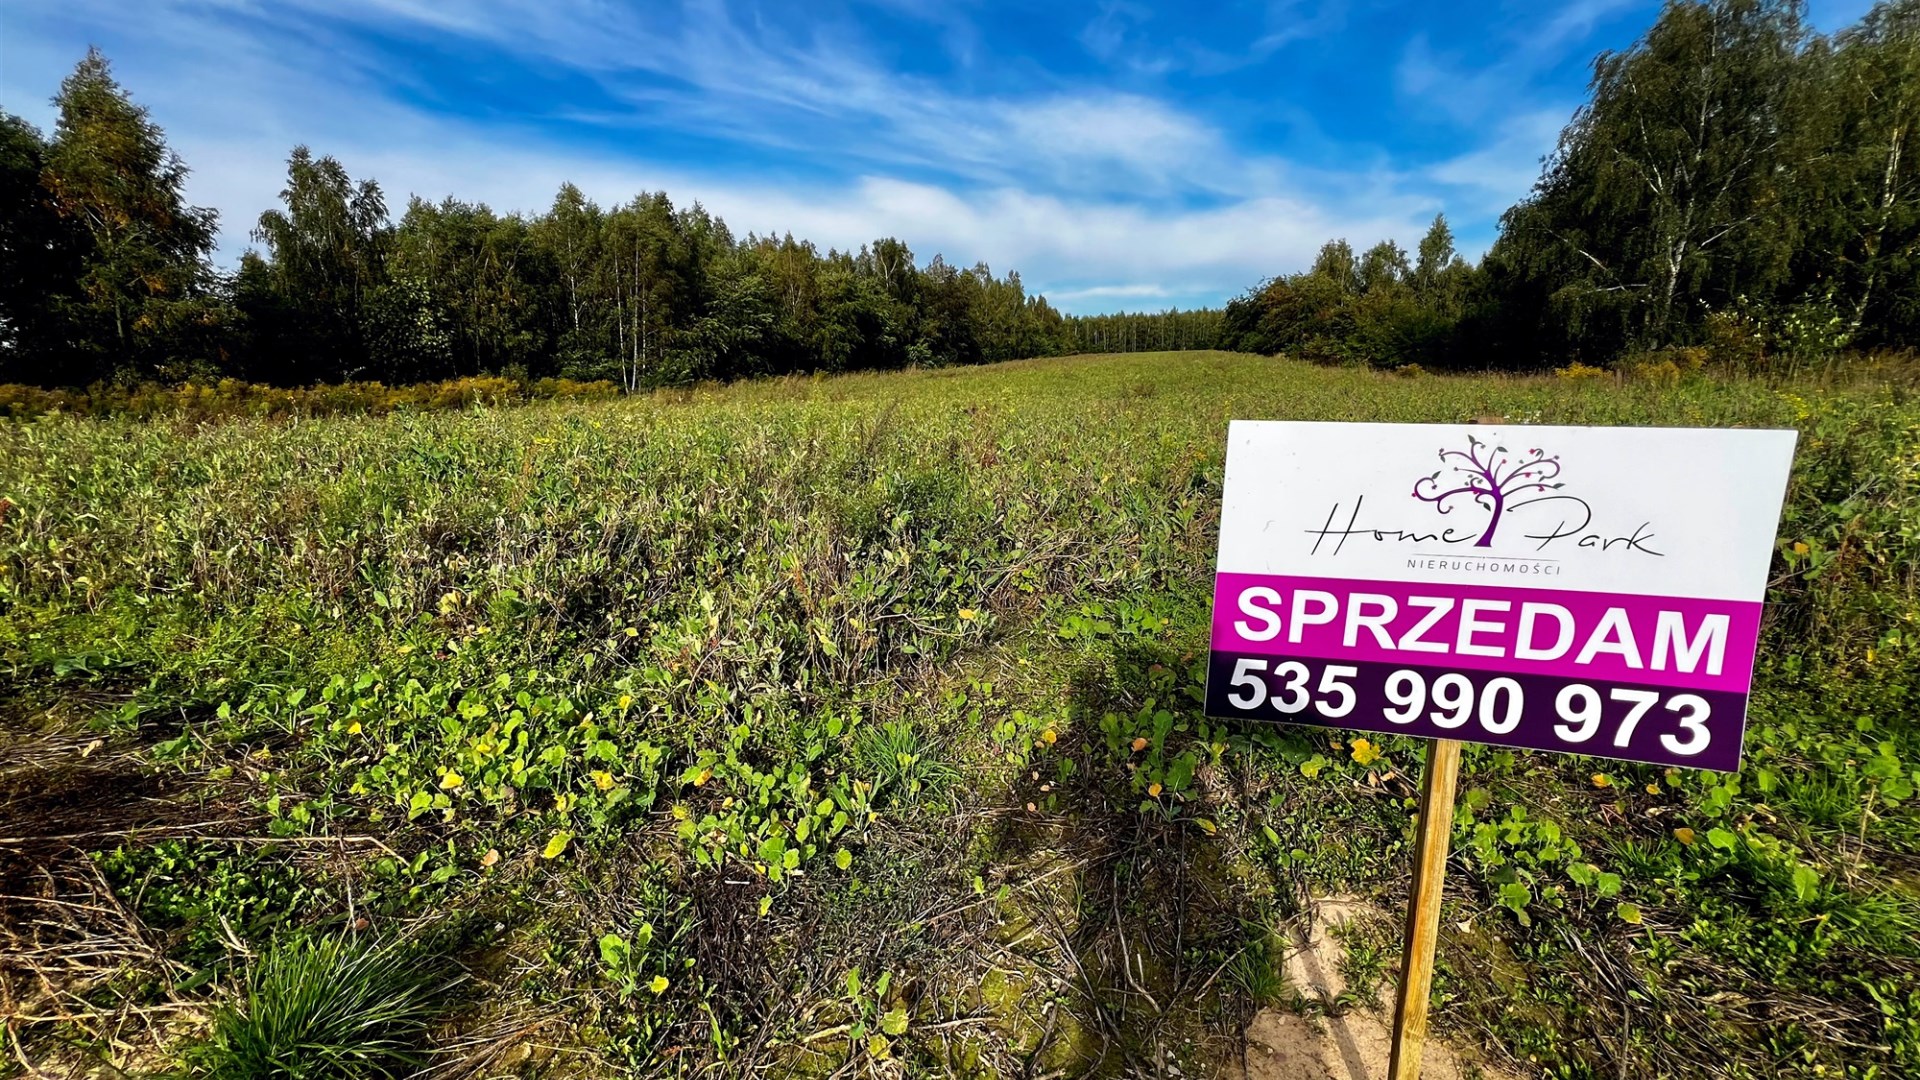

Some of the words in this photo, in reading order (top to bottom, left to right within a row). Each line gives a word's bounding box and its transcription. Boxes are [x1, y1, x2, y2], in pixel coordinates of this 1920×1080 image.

[1304, 494, 1477, 556] Home
[1506, 495, 1665, 557] Park
[1407, 558, 1561, 576] NIERUCHOMOŚCI
[1233, 586, 1731, 676] SPRZEDAM
[1227, 658, 1358, 718] 535
[1383, 670, 1525, 735] 990
[1553, 683, 1713, 756] 973
